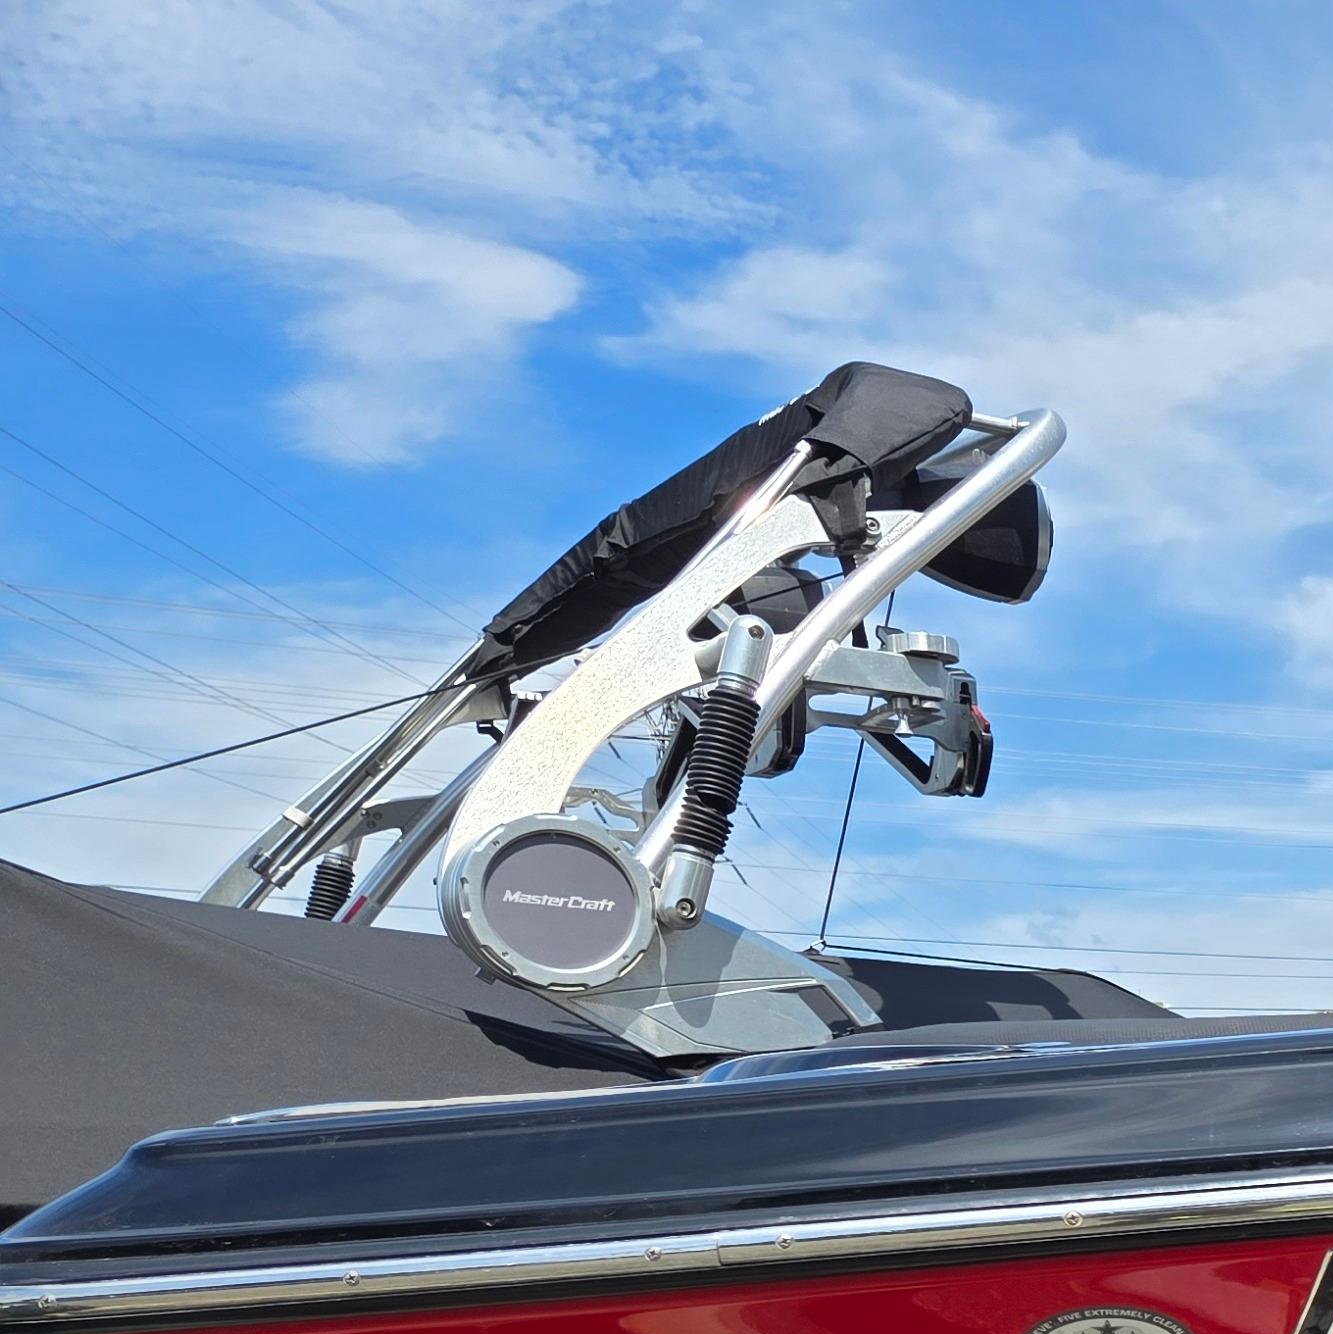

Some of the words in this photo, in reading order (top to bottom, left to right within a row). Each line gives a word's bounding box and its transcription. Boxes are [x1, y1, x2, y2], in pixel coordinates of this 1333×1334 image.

[502, 889, 616, 912] MasterCraft
[1058, 1311, 1082, 1324] FIVE
[1084, 1308, 1151, 1320] EXTREMELY
